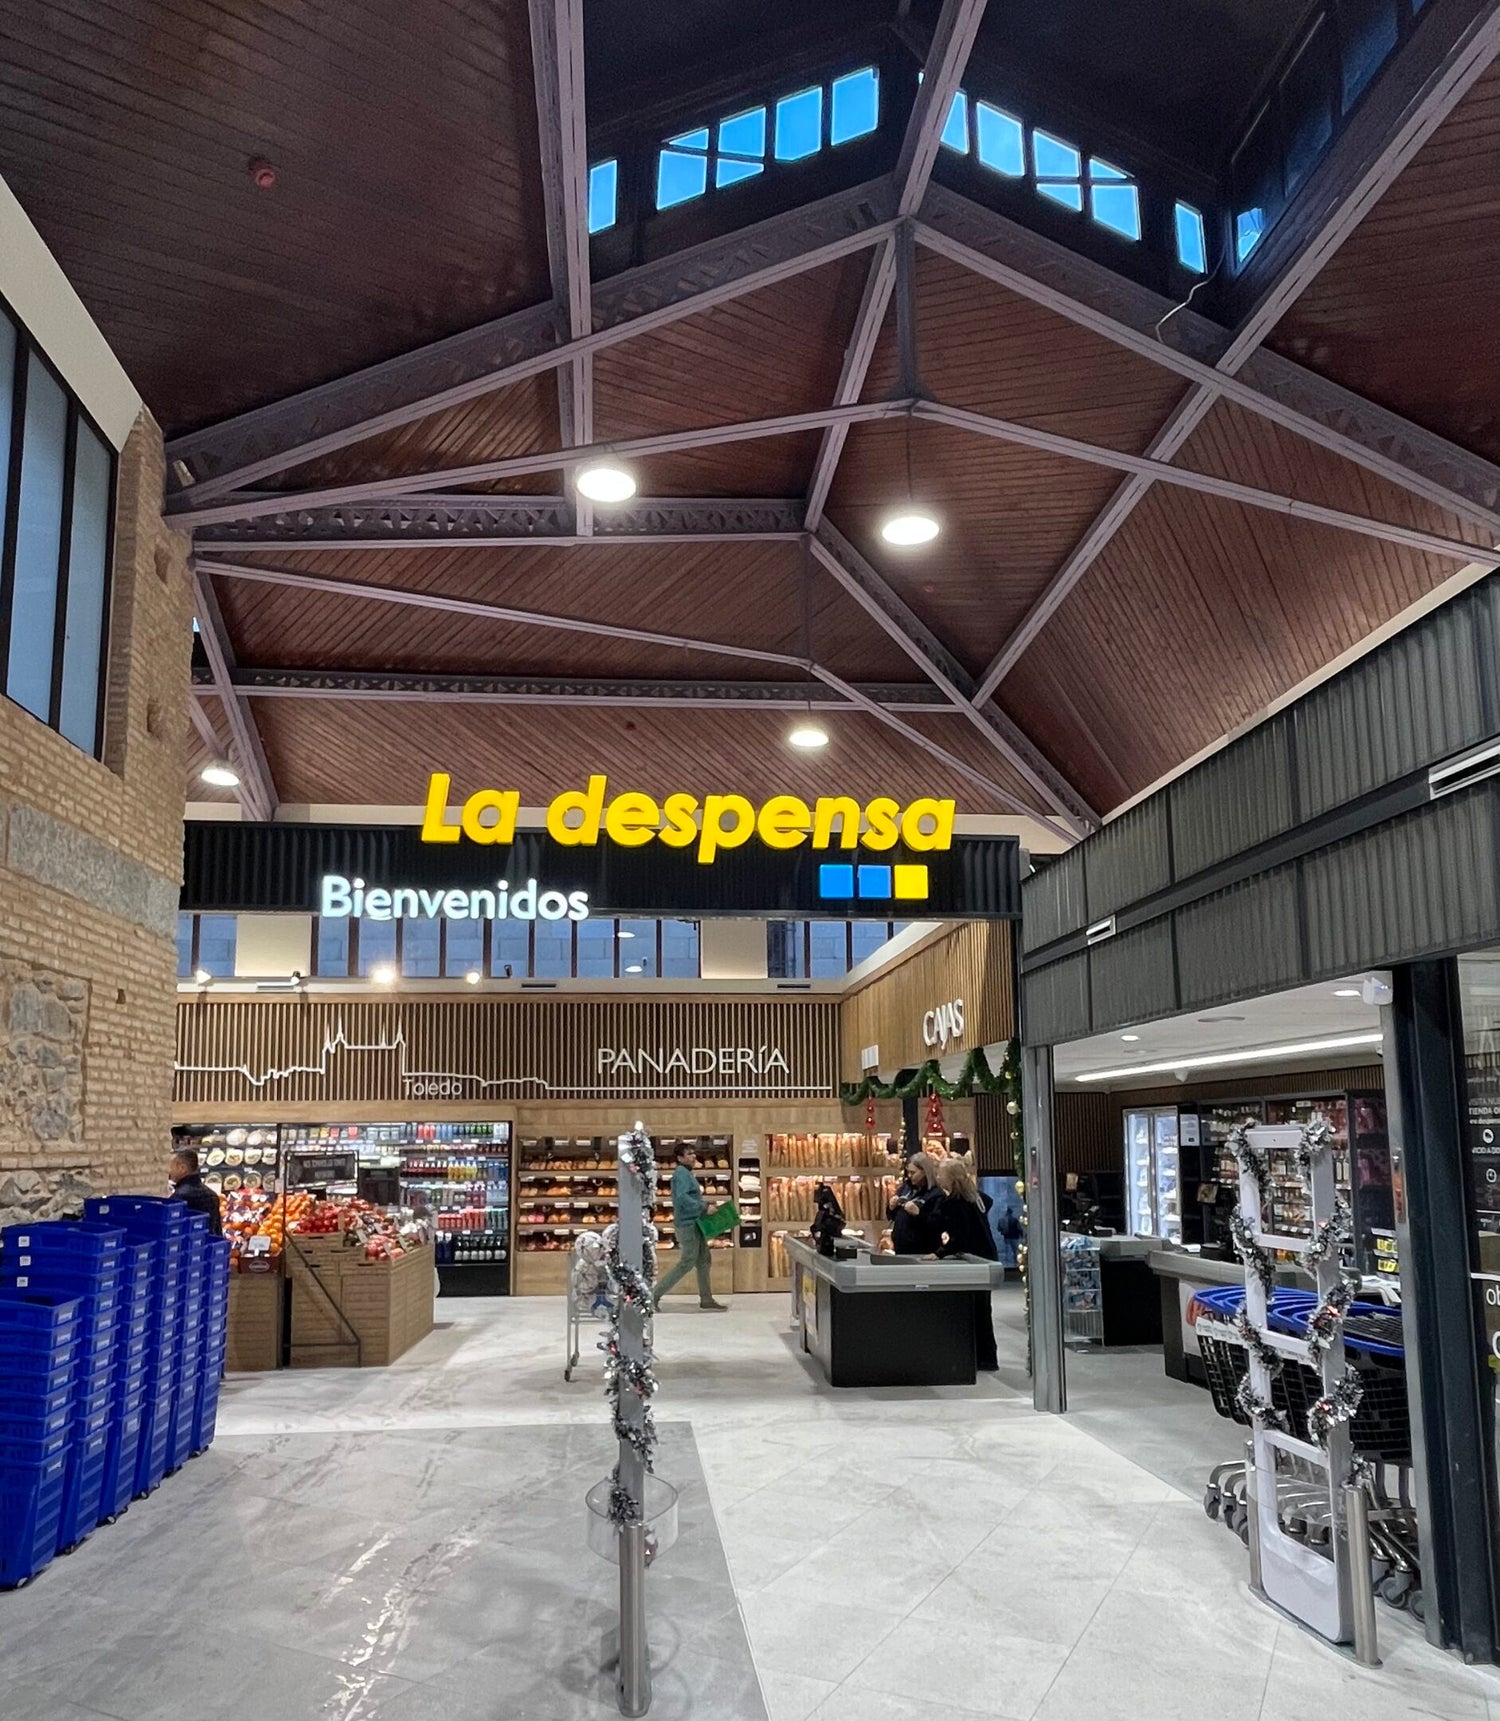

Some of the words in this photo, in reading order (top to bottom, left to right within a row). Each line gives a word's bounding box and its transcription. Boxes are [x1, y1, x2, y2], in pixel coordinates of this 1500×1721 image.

[421, 773, 520, 845] La
[546, 774, 956, 864] despensa
[321, 874, 590, 921] Bienvenidos
[923, 998, 964, 1050] CAJAS
[598, 1045, 790, 1074] PANADERÍA
[402, 1079, 462, 1096] Toledo
